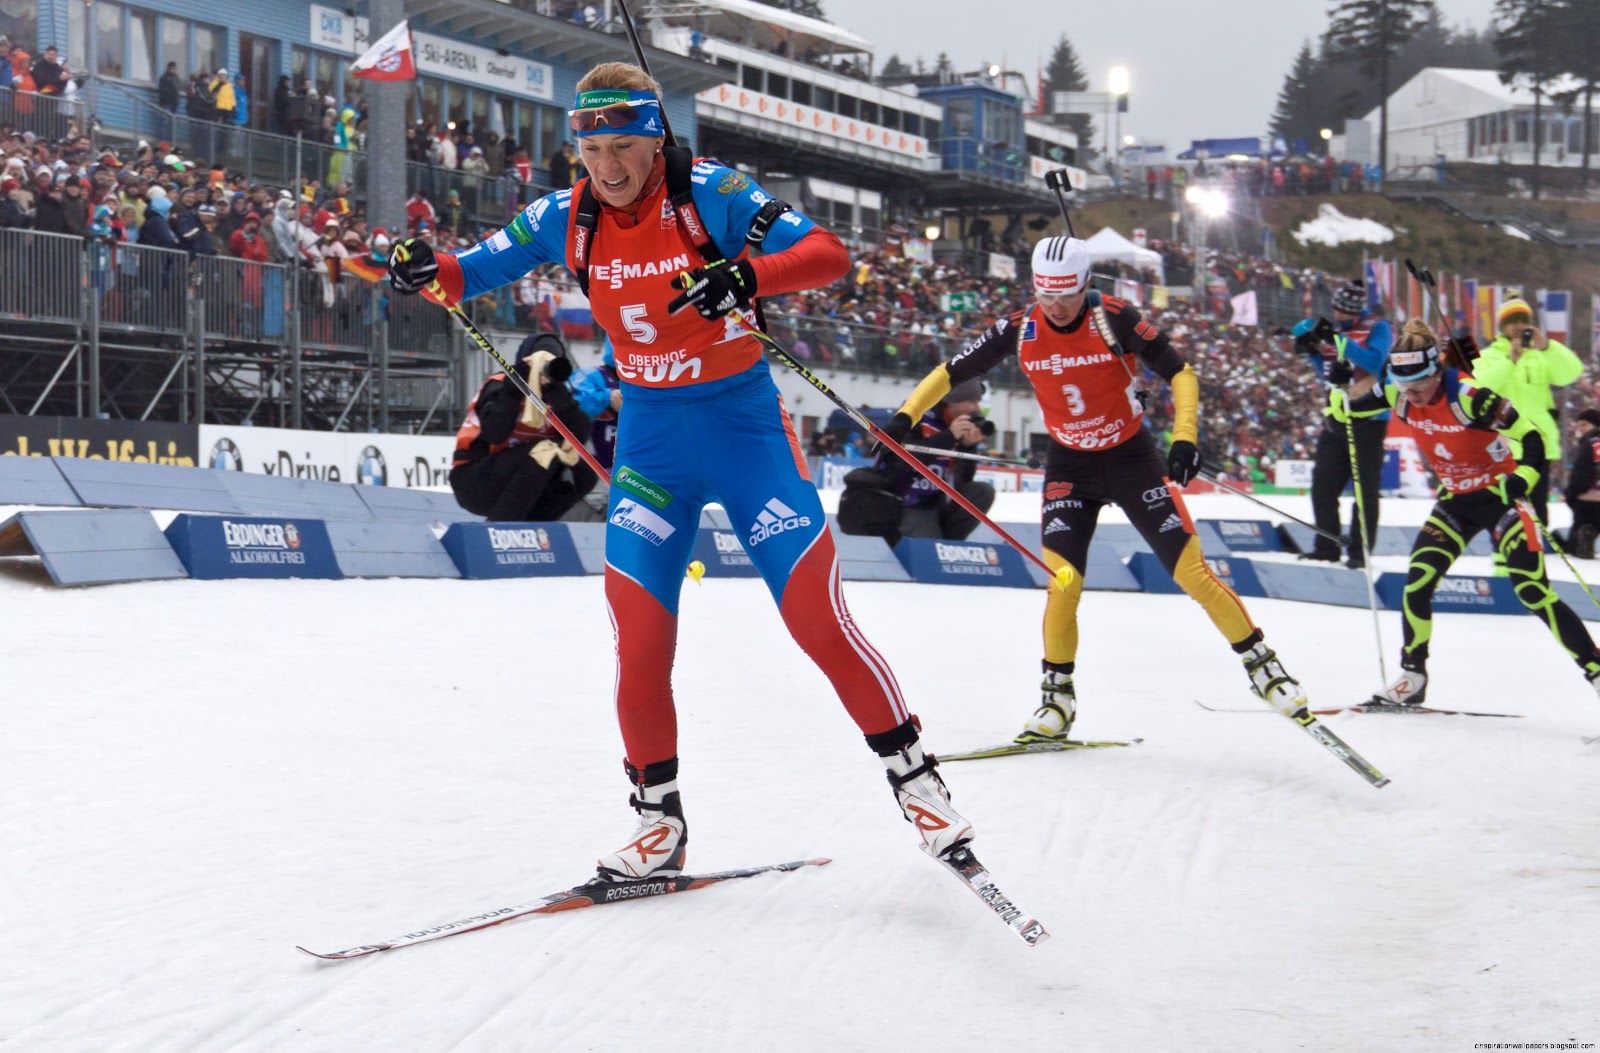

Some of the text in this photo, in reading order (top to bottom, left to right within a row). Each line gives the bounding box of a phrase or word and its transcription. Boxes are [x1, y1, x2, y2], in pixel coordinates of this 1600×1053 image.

[620, 303, 658, 345] 5
[628, 349, 687, 368] OBERHOF
[1024, 353, 1113, 375] VIESSMANN
[1062, 383, 1087, 417] 3
[1062, 415, 1107, 431] OBERHOF
[1434, 442, 1453, 461] 4
[222, 520, 288, 550] ERDINGER
[621, 519, 664, 545] GAZPROM
[749, 516, 812, 547] adidas
[229, 551, 306, 565] ALKOHOLFREI
[606, 882, 666, 901] ROSSIGNOL
